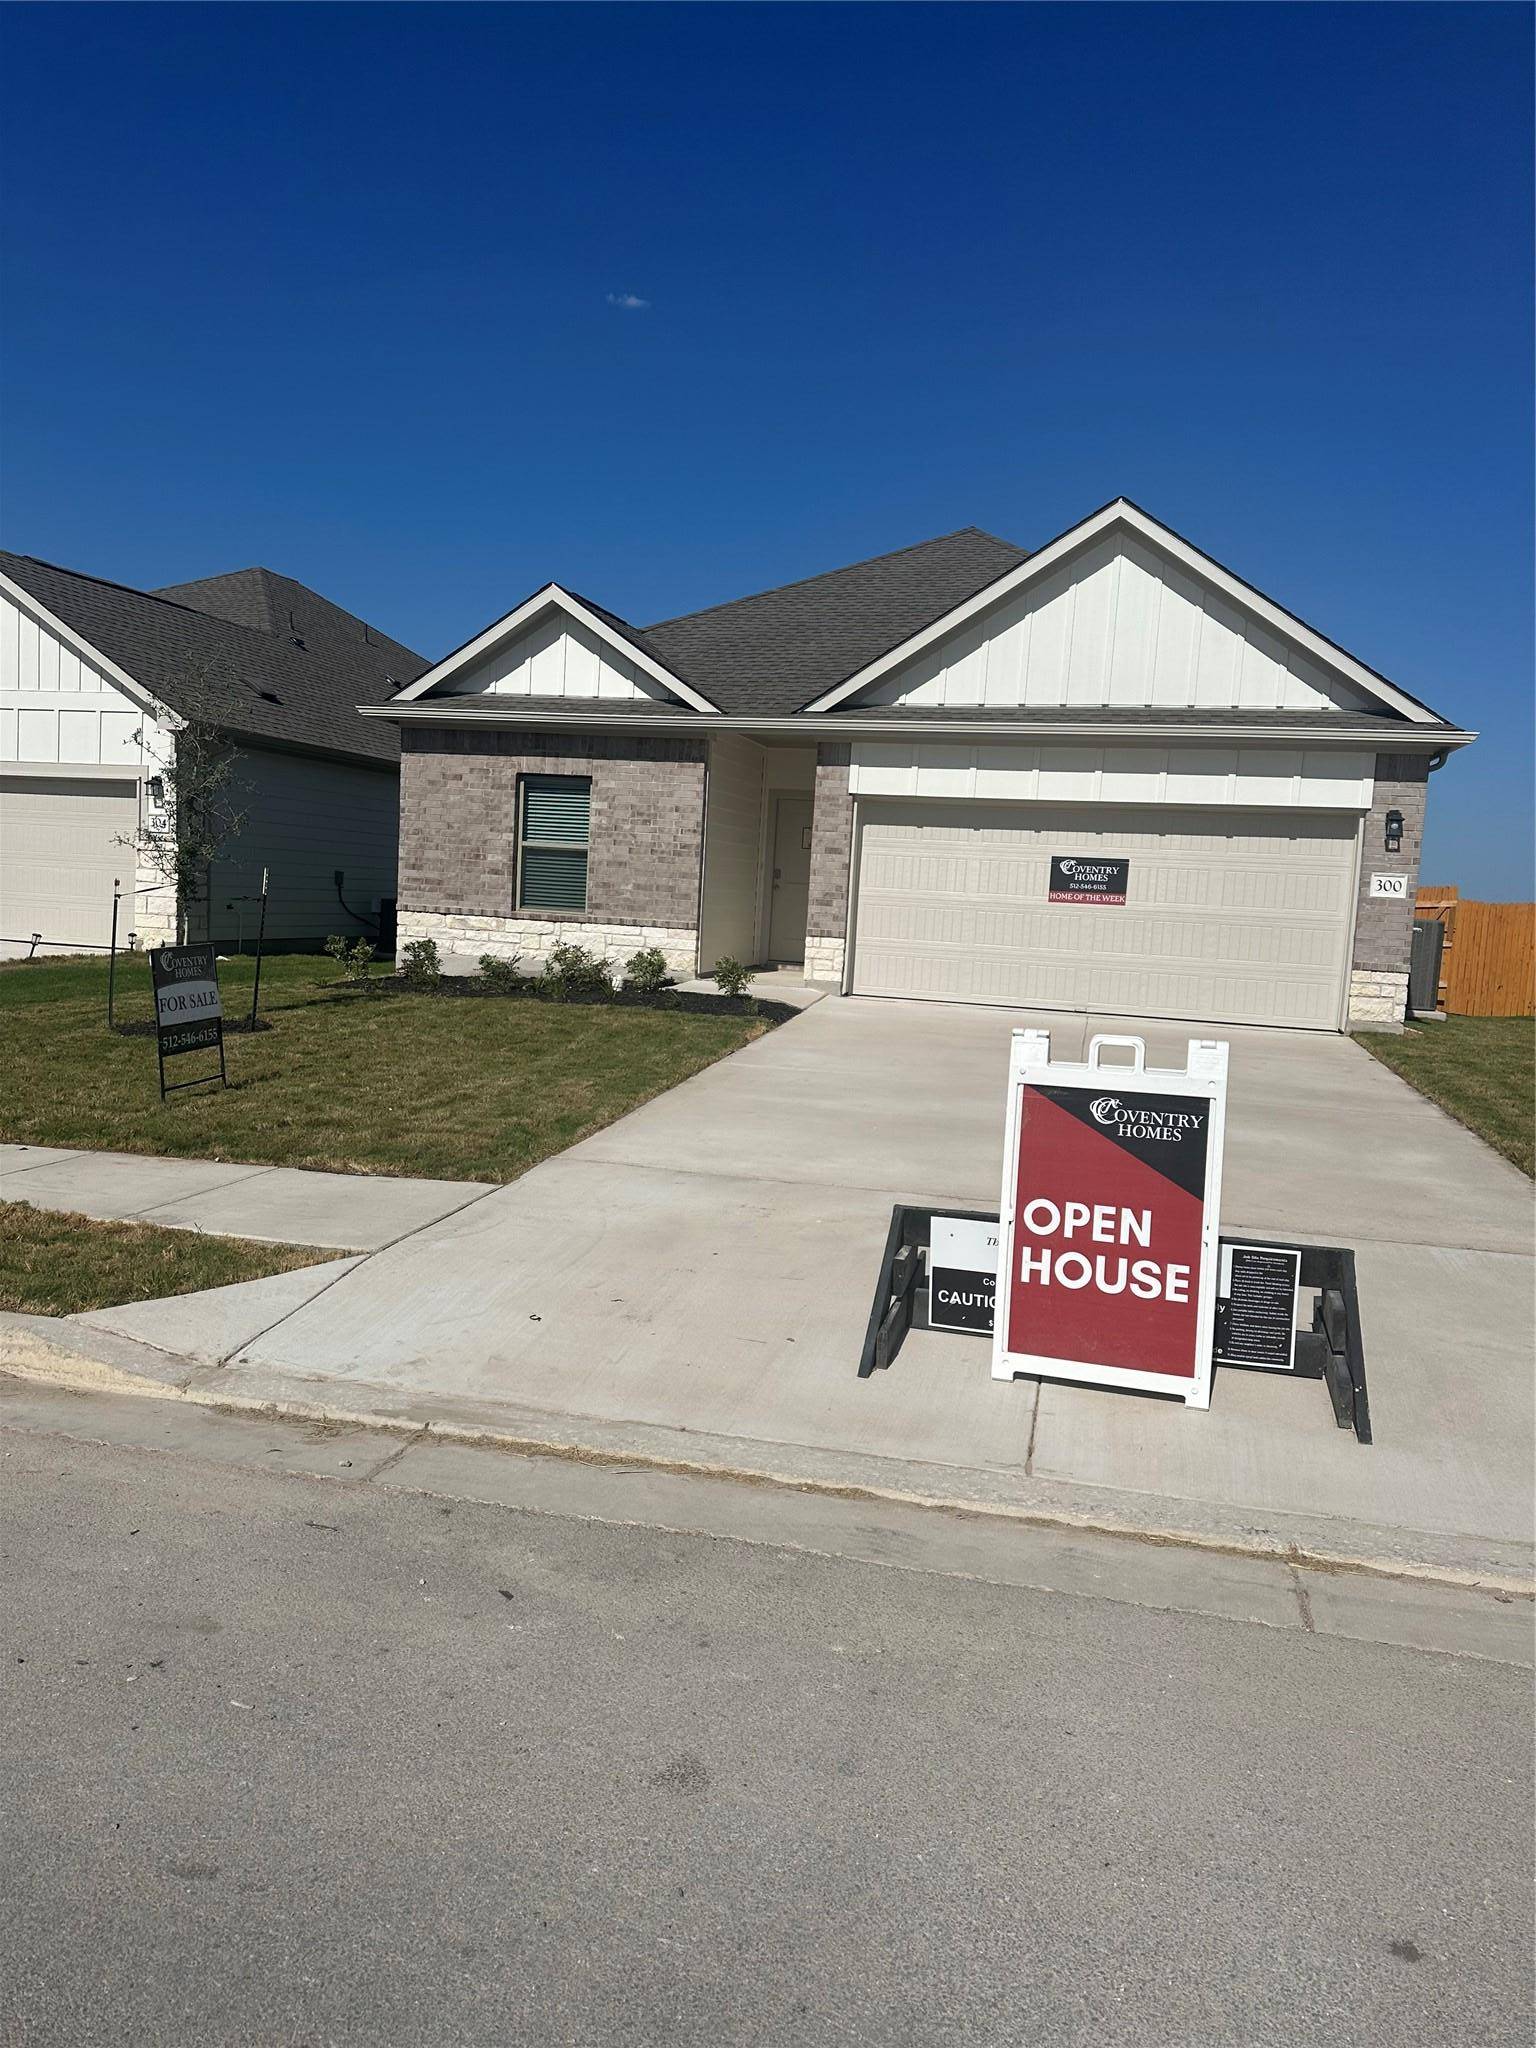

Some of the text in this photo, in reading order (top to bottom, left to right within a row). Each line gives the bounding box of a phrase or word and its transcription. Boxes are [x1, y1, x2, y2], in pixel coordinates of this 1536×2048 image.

[1060, 859, 1119, 874] COVENTRY
[1074, 873, 1108, 881] HOMES
[1375, 880, 1402, 892] 300
[160, 951, 208, 972] COVENTRY
[175, 968, 202, 979] HOMES
[159, 991, 218, 1013] FOR SALE
[1089, 1096, 1204, 1130] COVENTRY
[1117, 1124, 1183, 1142] HOMES
[1022, 1197, 1152, 1248] OPEN
[1020, 1244, 1191, 1303] HOUSE
